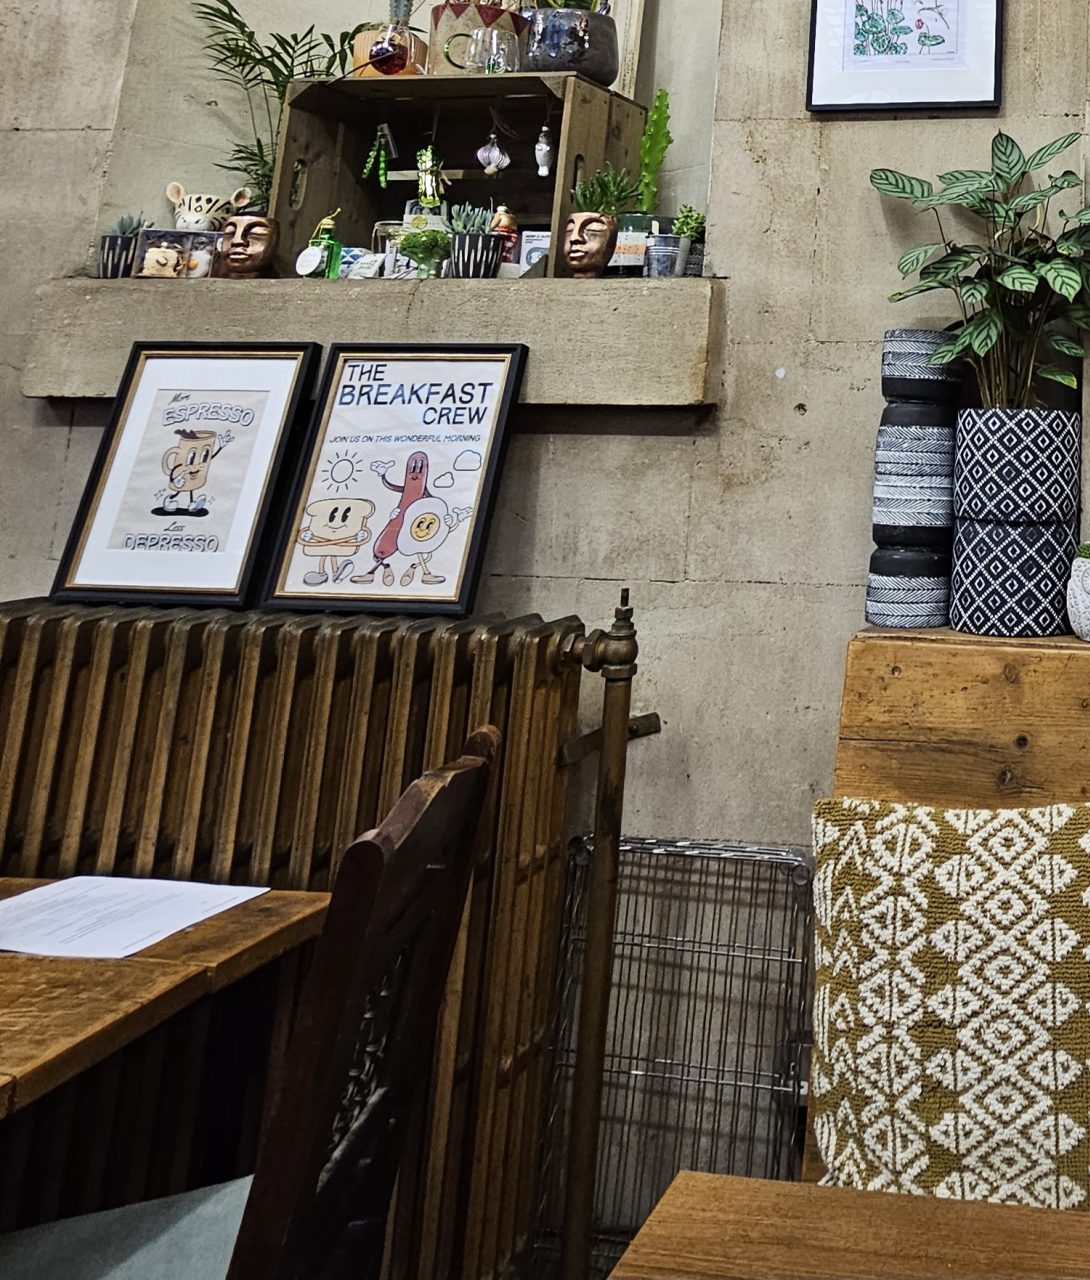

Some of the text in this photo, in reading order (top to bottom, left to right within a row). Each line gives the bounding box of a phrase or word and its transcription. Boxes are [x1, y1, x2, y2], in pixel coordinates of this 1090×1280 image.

[348, 364, 387, 381] THE
[338, 382, 493, 405] BREAKFAST
[163, 402, 254, 426] ESPRESSO
[422, 407, 488, 425] CREW
[329, 434, 481, 443] JOIN US ON THIS WONDERFUL MORNING
[124, 533, 219, 552] DEPRESSO
